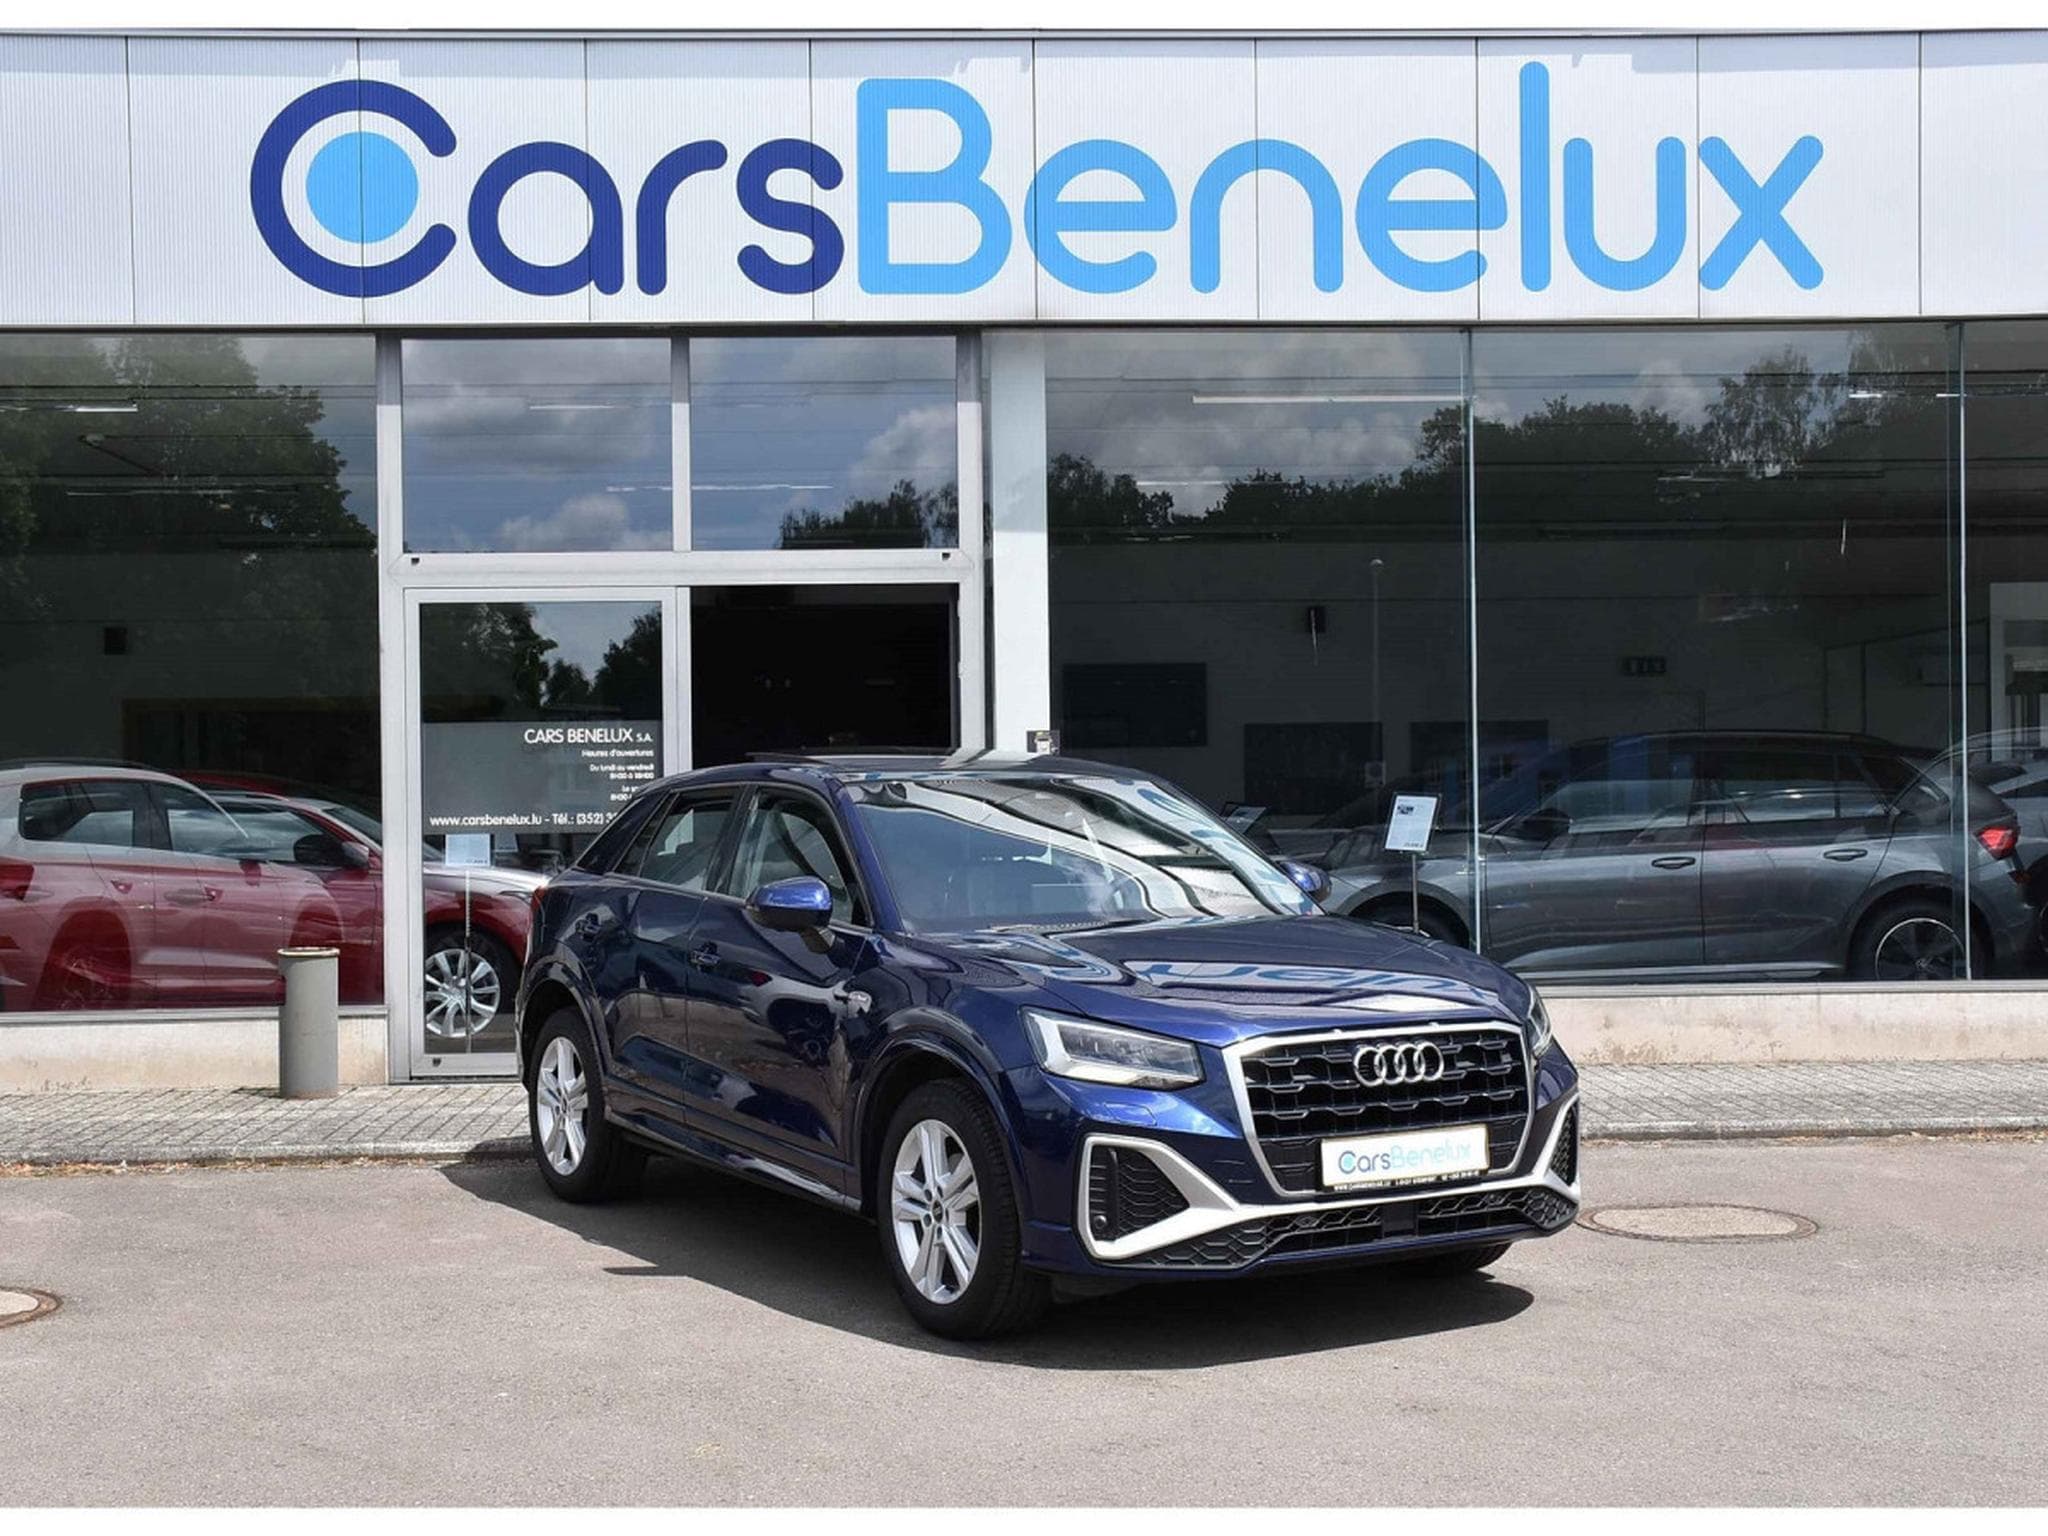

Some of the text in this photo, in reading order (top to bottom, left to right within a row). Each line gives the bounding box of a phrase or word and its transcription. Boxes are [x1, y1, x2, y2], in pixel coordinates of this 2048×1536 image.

[250, 61, 1824, 298] CarsBenelux
[524, 728, 564, 743] CARS
[567, 728, 633, 743] BENELUX
[429, 813, 542, 826] www.carsbenelux.lu
[576, 812, 604, 825] (352)
[1338, 1140, 1472, 1175] CarsBenelux
